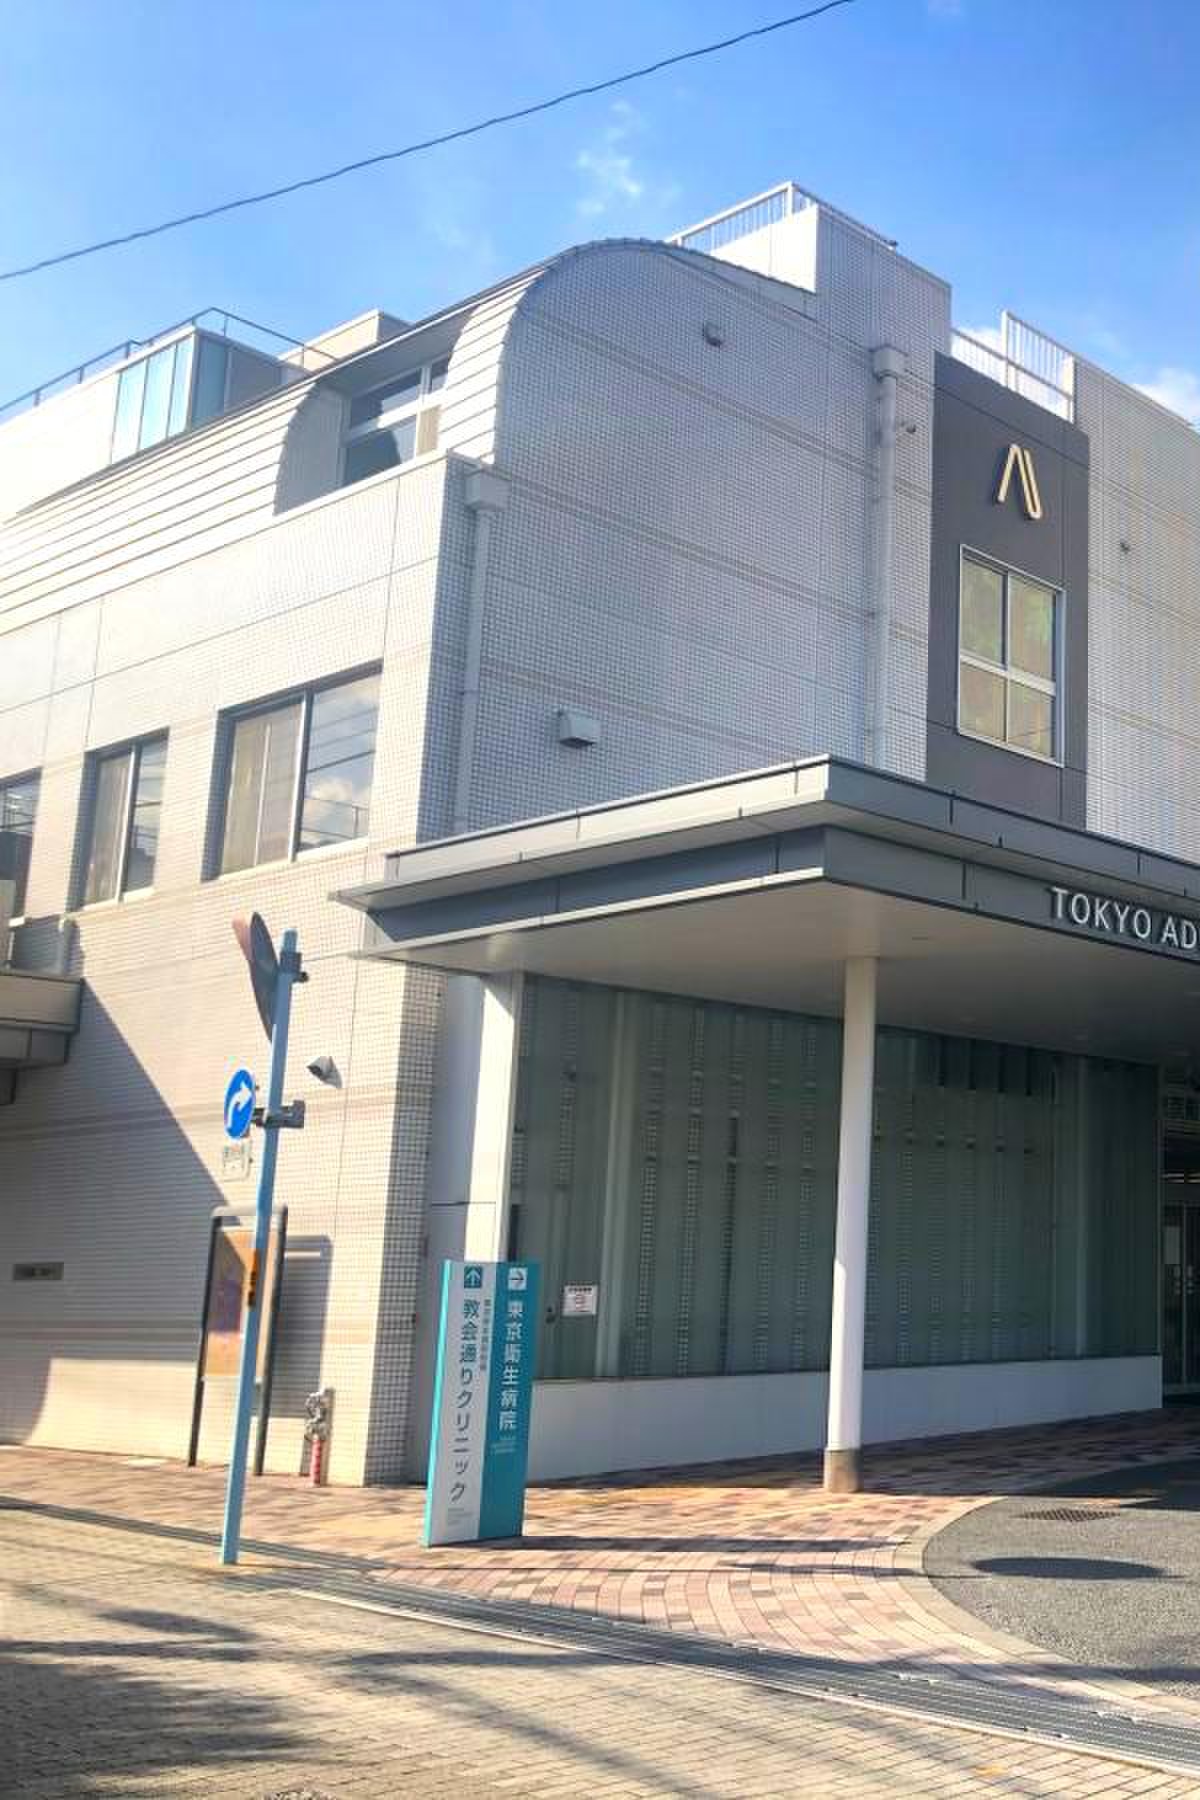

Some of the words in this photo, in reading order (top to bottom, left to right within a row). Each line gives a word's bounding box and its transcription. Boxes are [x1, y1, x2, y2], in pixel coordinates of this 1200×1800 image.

[1051, 886, 1152, 939] TOKYO
[450, 1299, 481, 1503] 教会通りクリニック
[499, 1300, 524, 1431] 東京衛生病院
